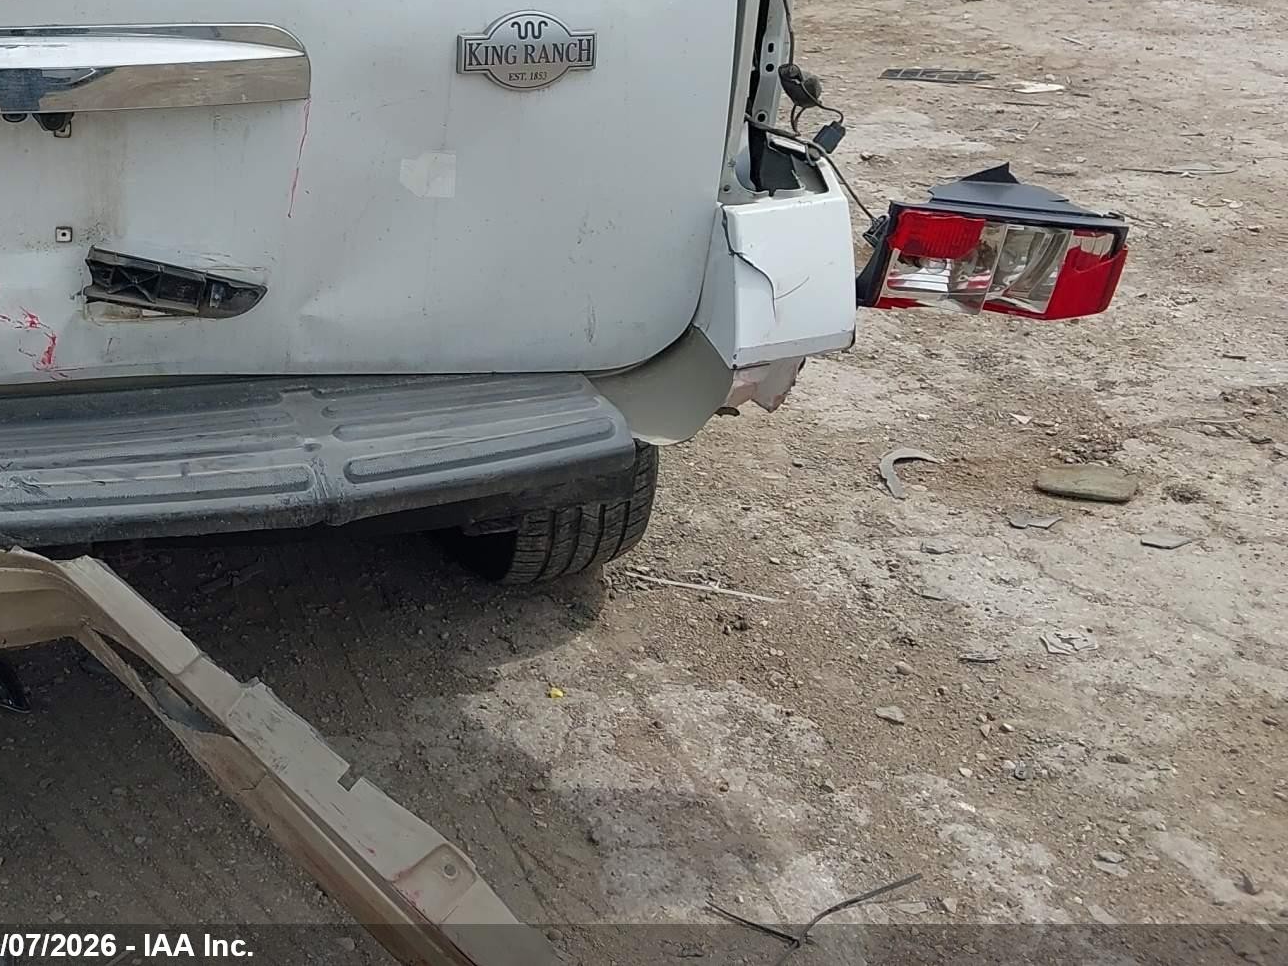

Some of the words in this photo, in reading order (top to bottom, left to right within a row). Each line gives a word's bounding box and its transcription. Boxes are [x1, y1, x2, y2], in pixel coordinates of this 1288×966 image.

[467, 42, 517, 67] KING
[523, 38, 593, 65] RANCH
[508, 72, 527, 82] EST.
[529, 71, 548, 81] 1853
